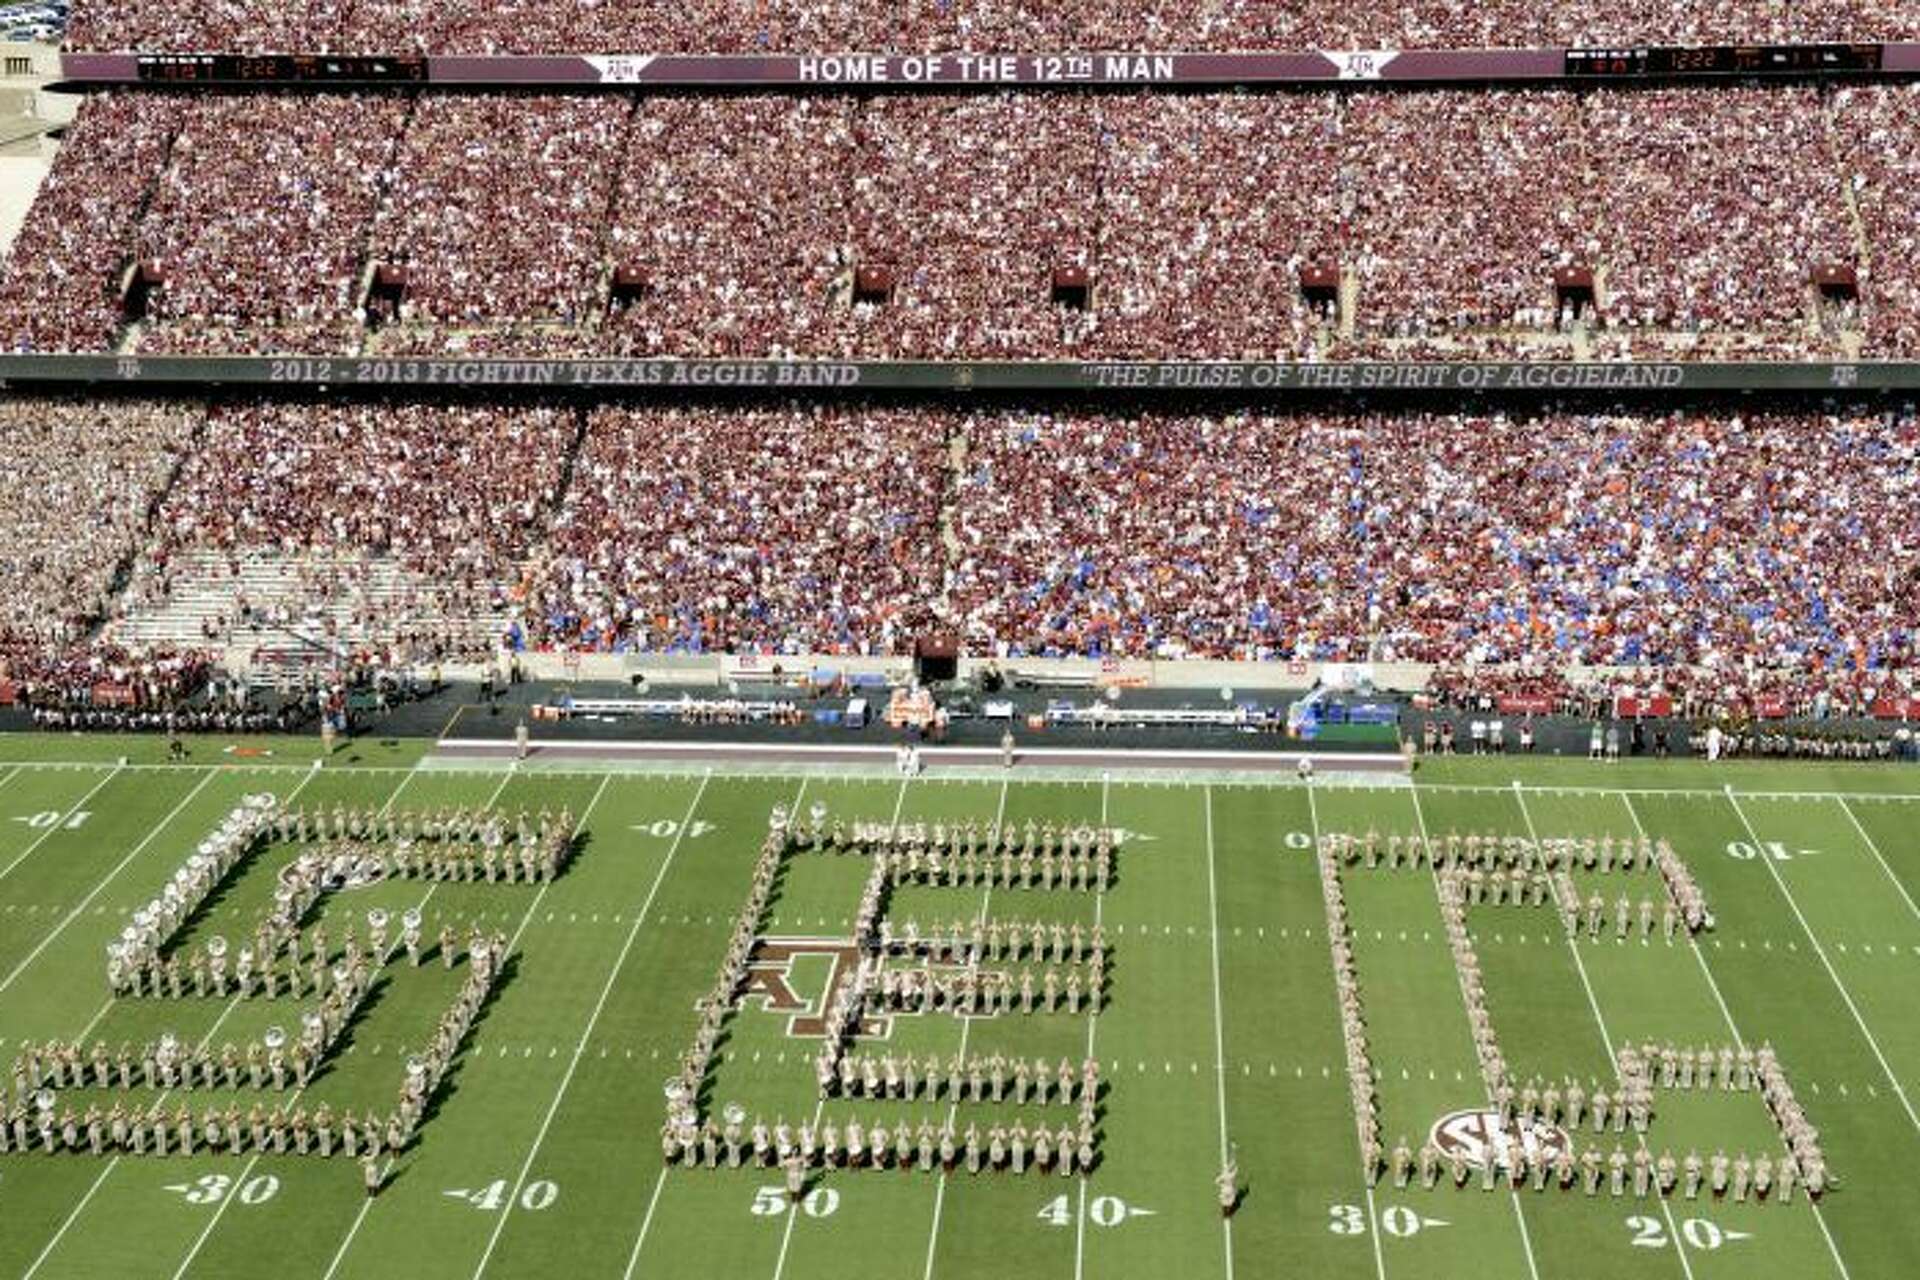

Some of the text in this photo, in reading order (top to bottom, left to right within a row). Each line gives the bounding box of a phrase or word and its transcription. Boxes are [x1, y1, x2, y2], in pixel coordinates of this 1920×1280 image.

[800, 56, 1174, 80] HOME OF THE 12TH MAN
[269, 361, 331, 381] 2012
[356, 362, 419, 382] 2013
[422, 362, 566, 384] FIGHTIN'
[571, 363, 662, 384] TEXAS
[668, 364, 769, 385] AGGIE
[775, 364, 860, 386] BAND
[1156, 365, 1244, 387] PULSE
[1250, 365, 1292, 387] OF
[1297, 365, 1356, 387] THE
[1359, 365, 1450, 388] SPIRIT
[1456, 365, 1500, 388] OF
[1504, 365, 1684, 388] AGGIELAND
